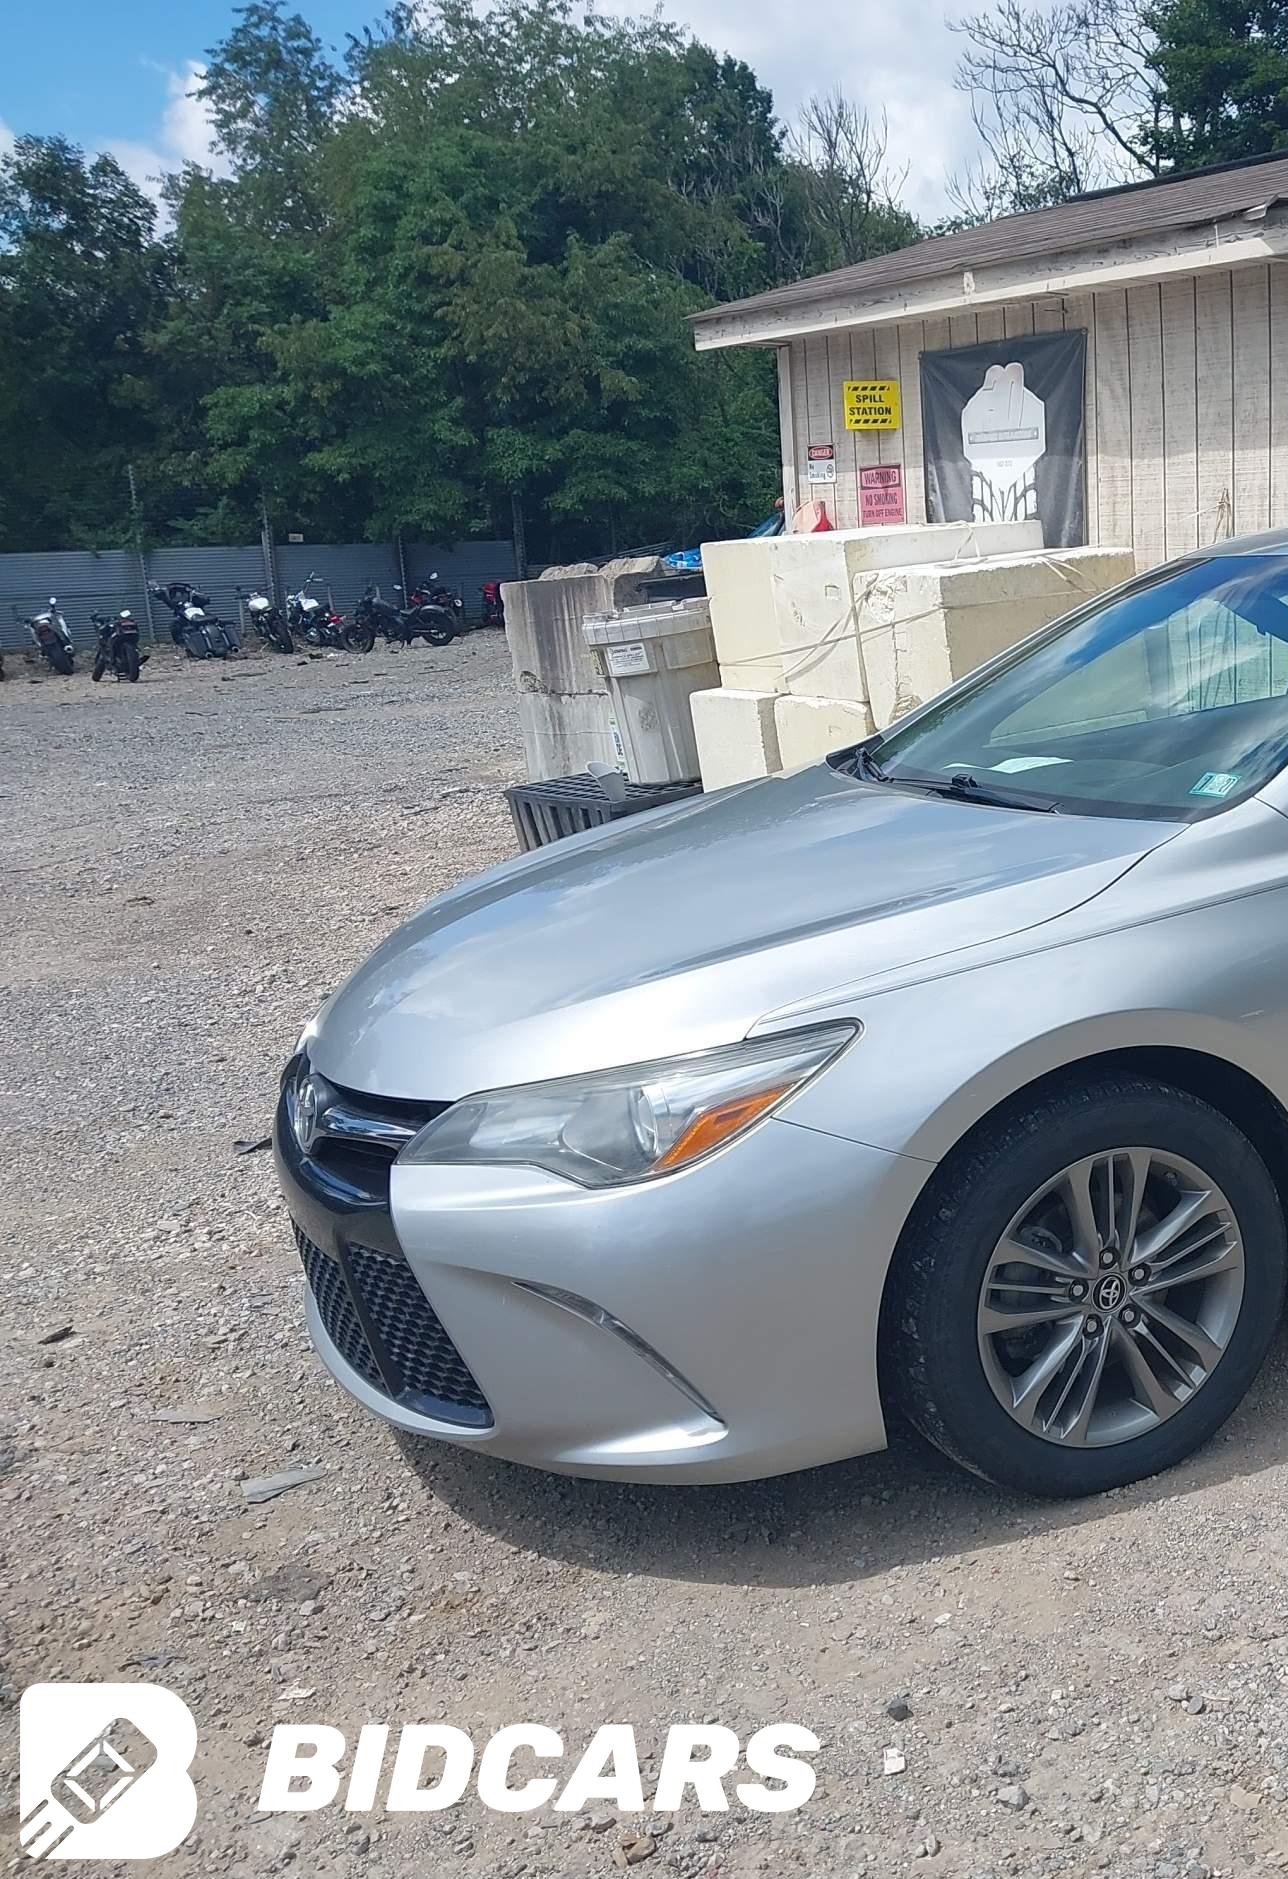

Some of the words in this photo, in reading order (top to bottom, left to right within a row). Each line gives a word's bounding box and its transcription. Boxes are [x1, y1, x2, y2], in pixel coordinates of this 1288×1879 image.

[855, 393, 885, 404] SPILL
[849, 405, 892, 417] STATION
[864, 470, 897, 485] WARNING
[865, 494, 873, 506] NO
[874, 493, 898, 506] SMOKING
